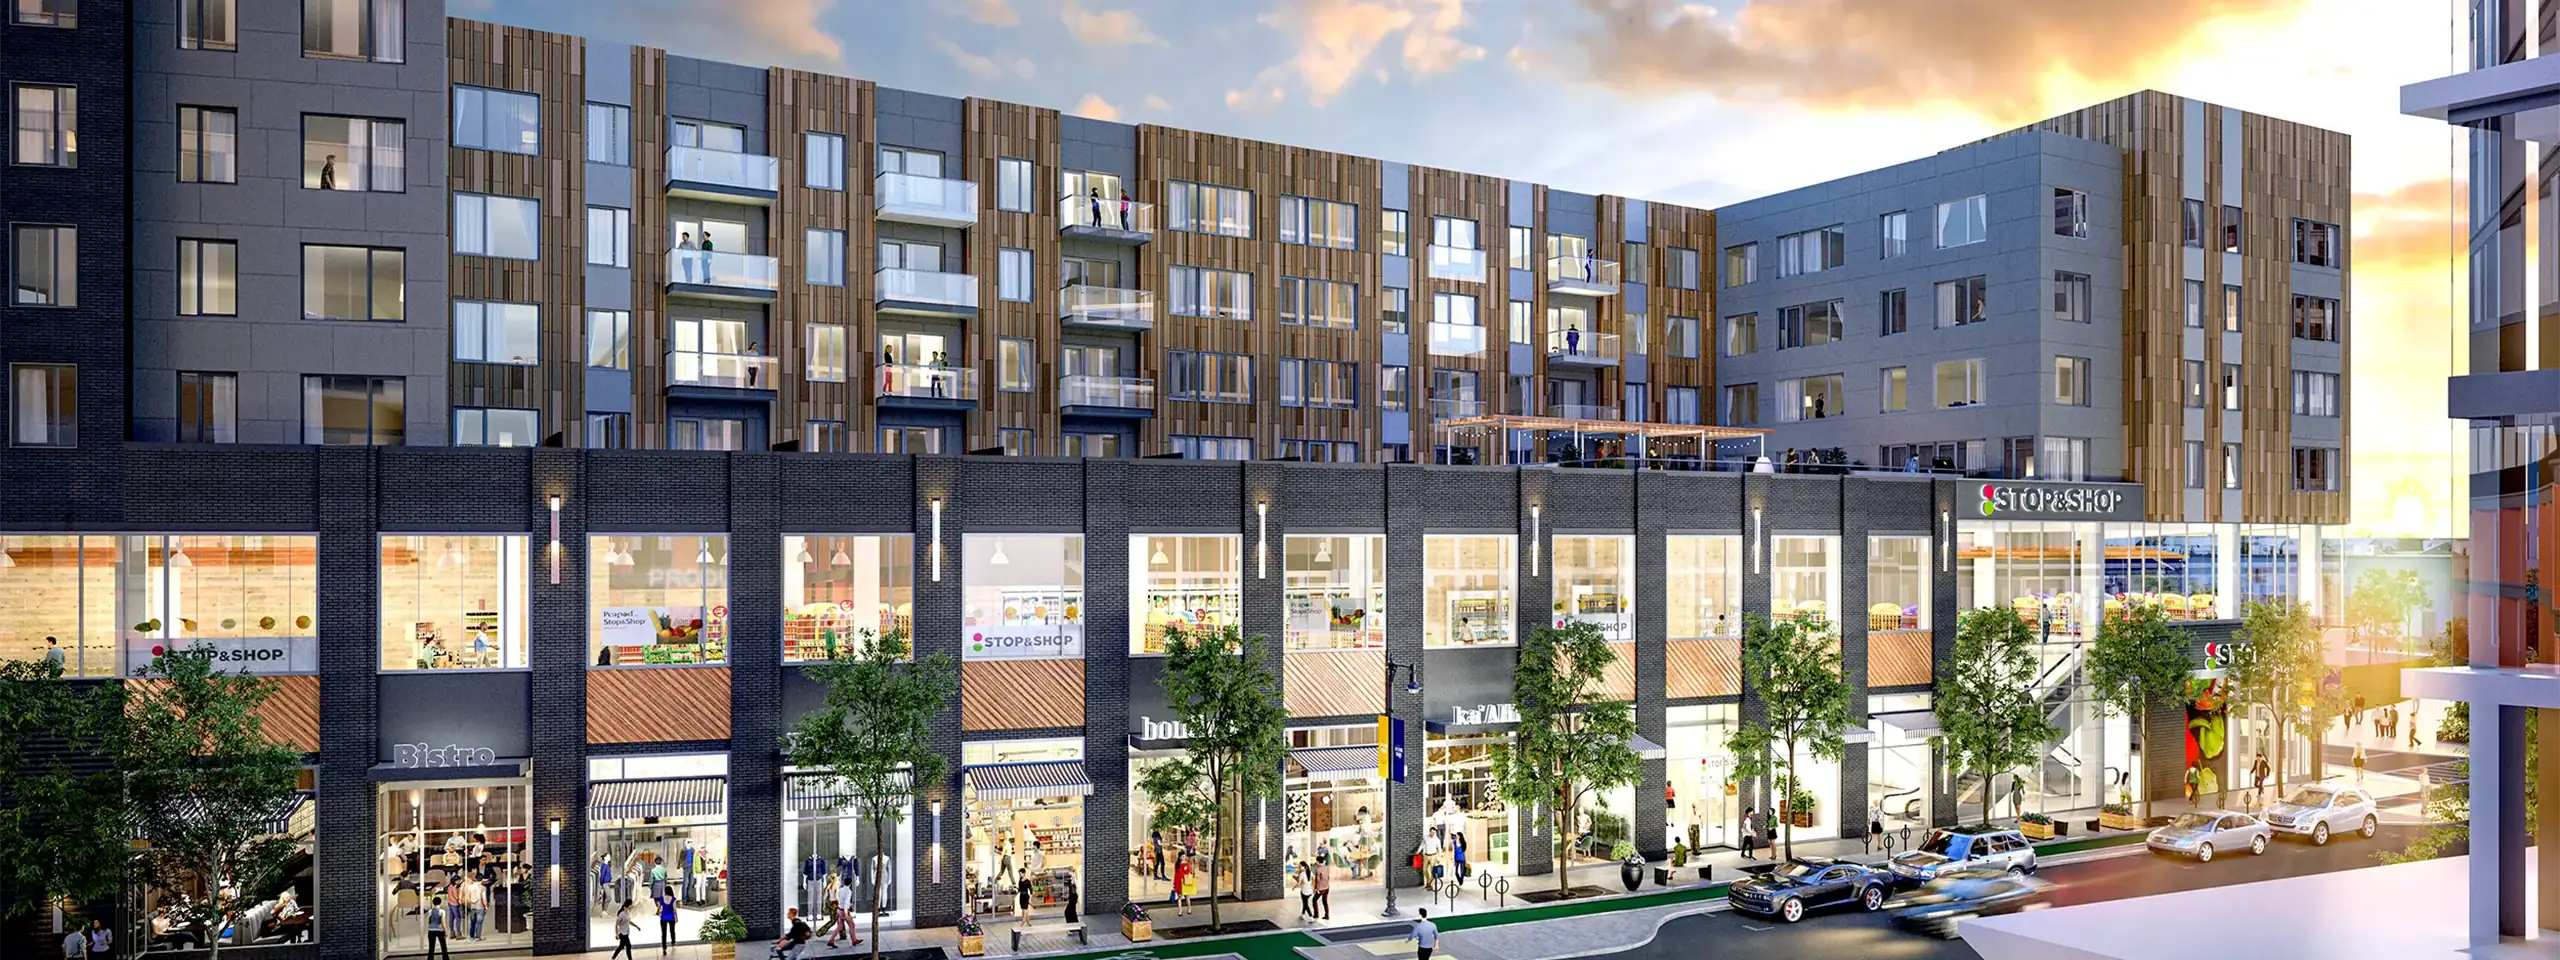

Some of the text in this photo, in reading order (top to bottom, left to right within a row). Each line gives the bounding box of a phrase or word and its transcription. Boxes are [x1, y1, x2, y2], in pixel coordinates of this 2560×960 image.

[1993, 486, 2124, 513] STOP&SHOP
[984, 635, 1073, 648] STOP&SHOP
[394, 742, 495, 769] Bistro
